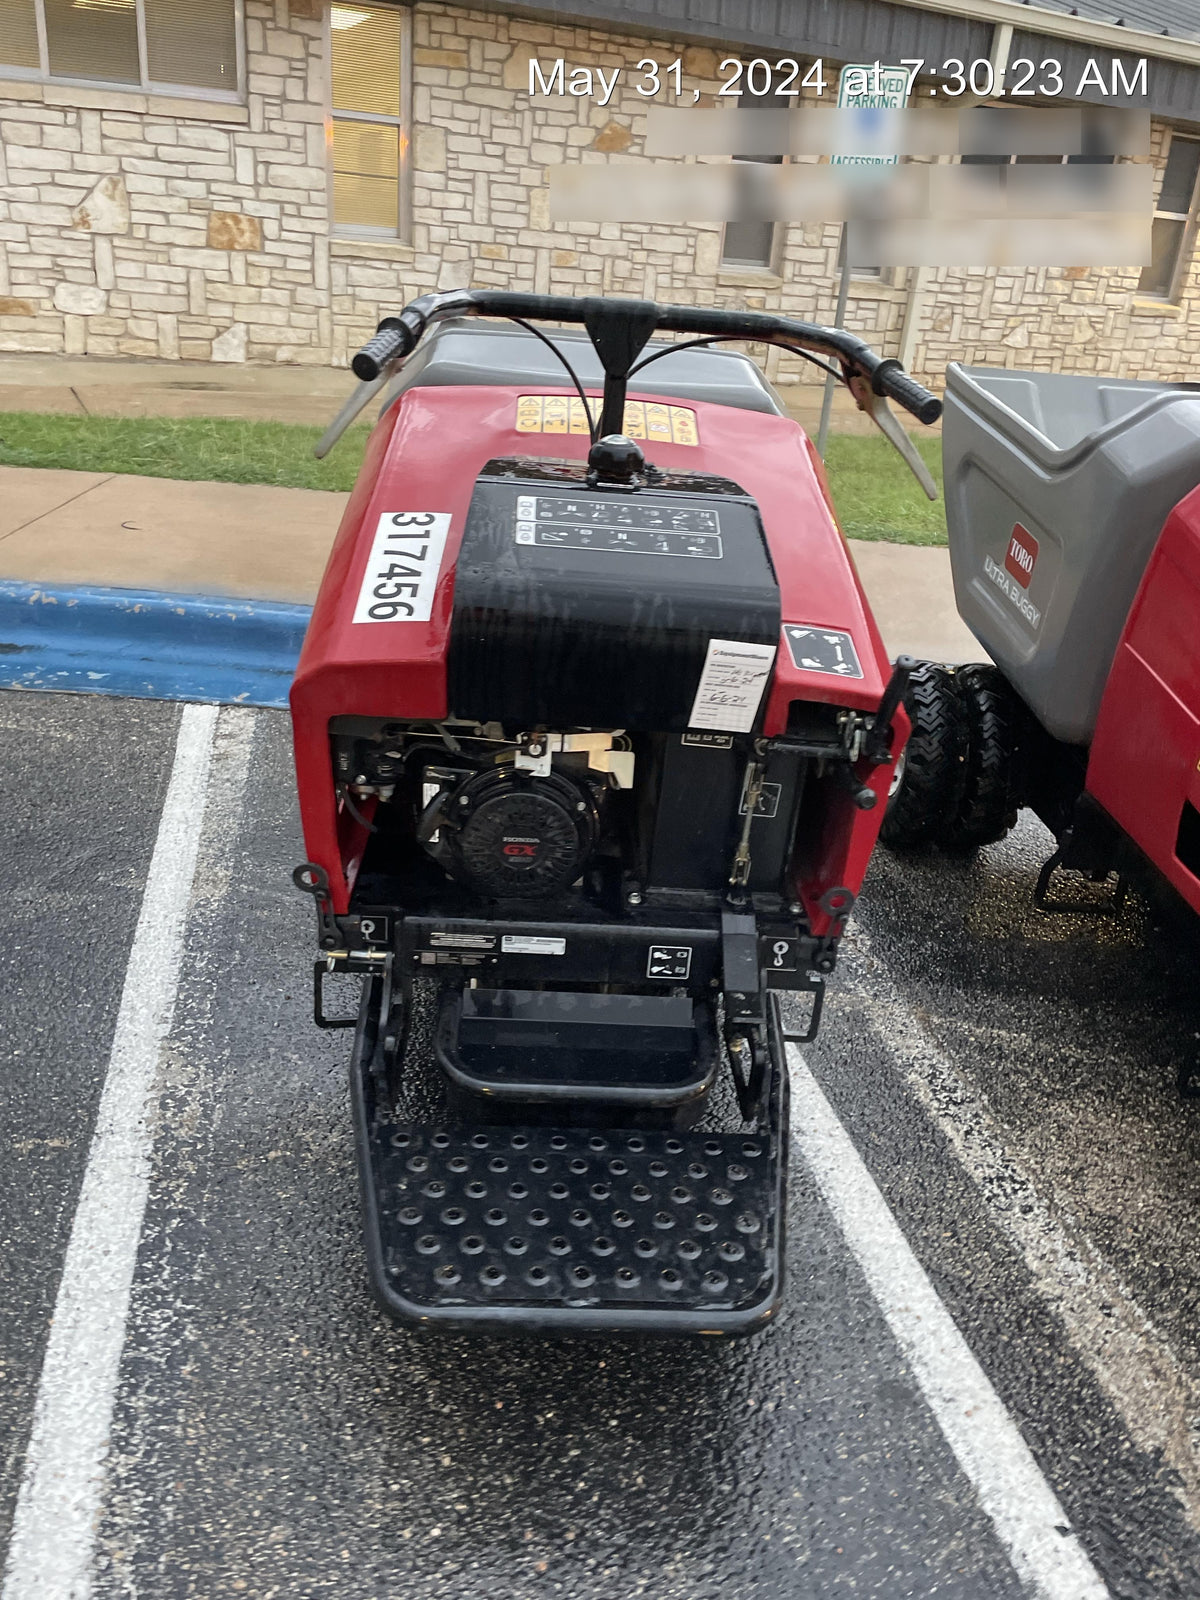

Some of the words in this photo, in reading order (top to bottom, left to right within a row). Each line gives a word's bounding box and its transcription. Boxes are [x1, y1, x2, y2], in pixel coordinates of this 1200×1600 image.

[847, 95, 897, 108] PARKING
[368, 513, 435, 619] 317456
[1010, 538, 1034, 573] TORO
[984, 558, 1009, 595] ULTRA
[1010, 586, 1039, 625] BUGGY
[503, 844, 538, 856] GX
